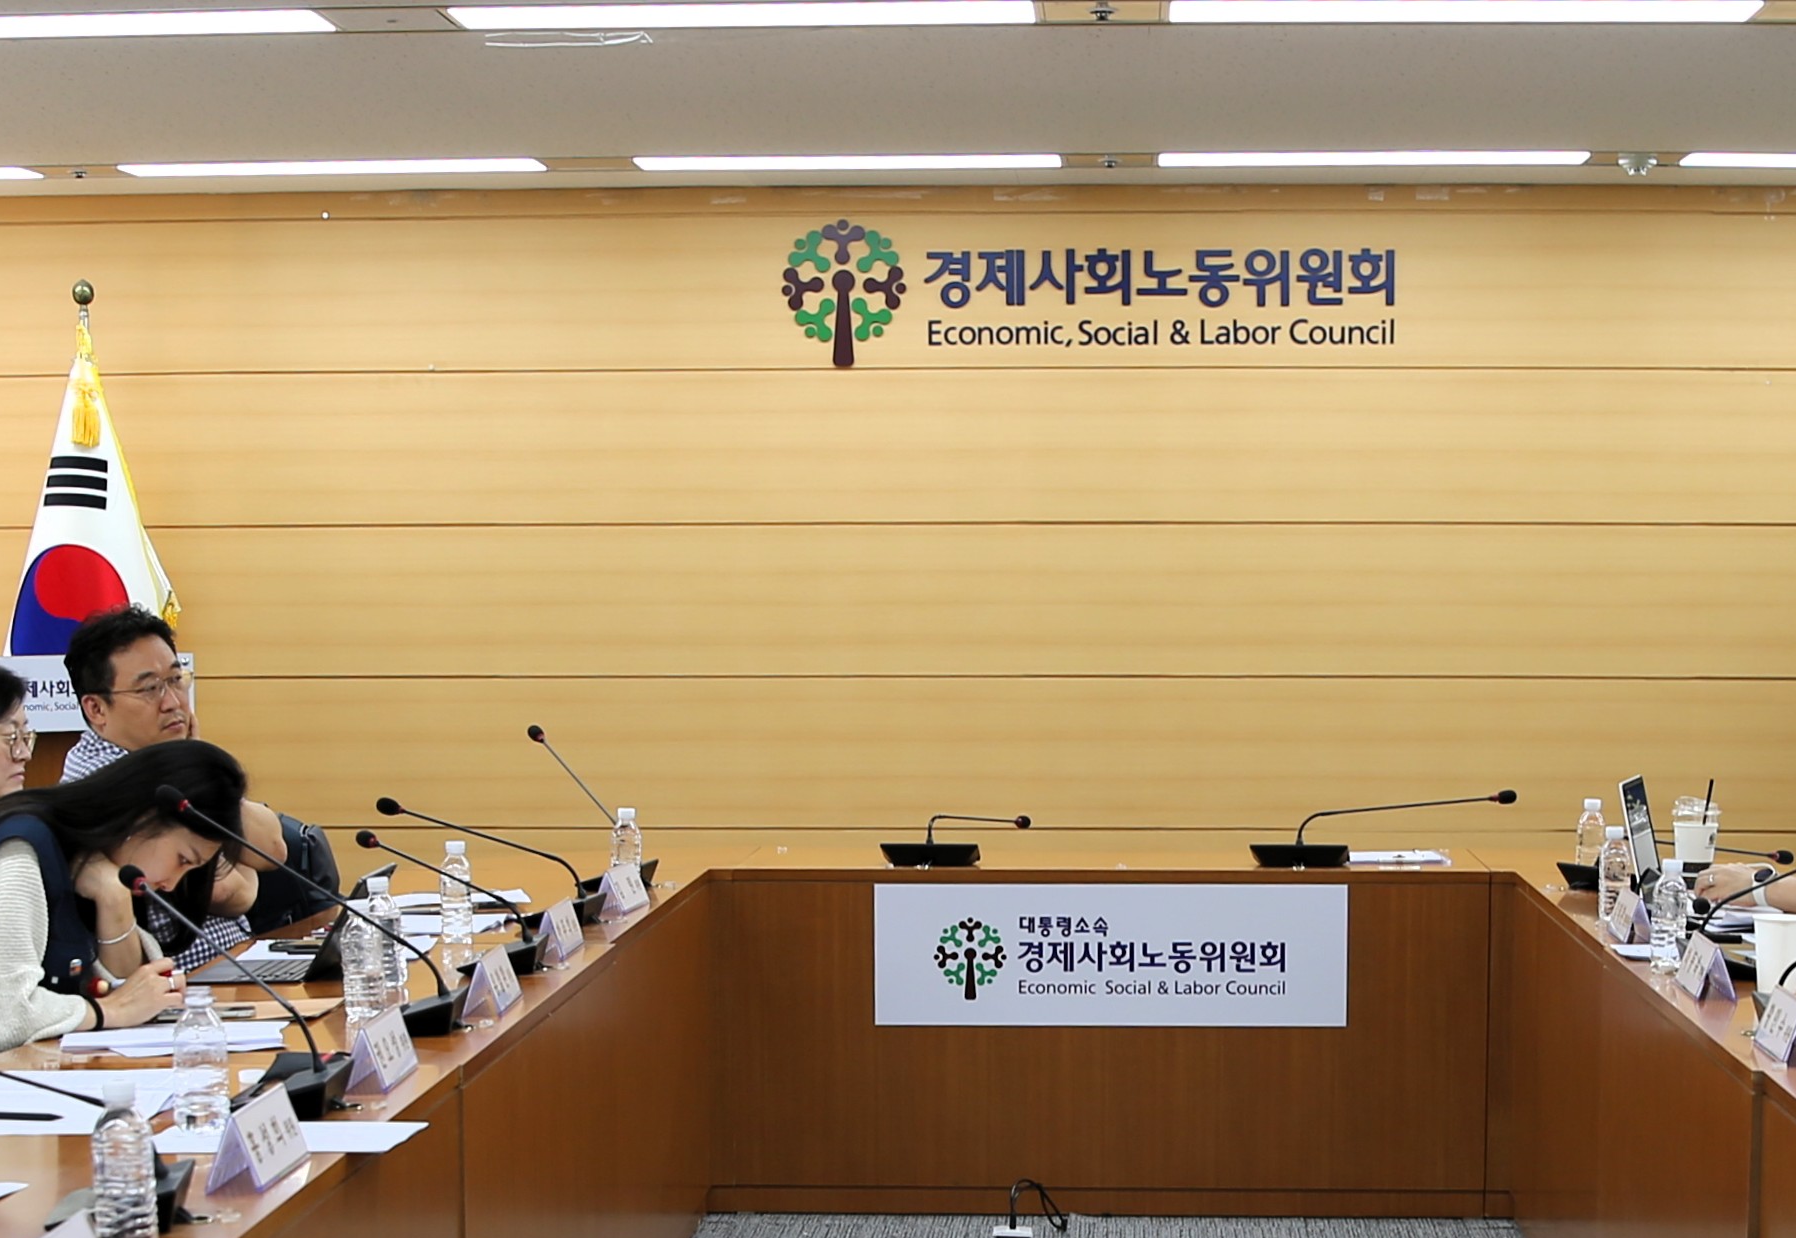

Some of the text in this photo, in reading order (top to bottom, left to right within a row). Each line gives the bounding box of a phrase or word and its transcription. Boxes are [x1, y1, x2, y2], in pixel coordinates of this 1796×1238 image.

[924, 248, 1396, 307] 경제사회노동위원회
[927, 319, 1396, 348] Economic, Social & Labor Council
[1018, 916, 1109, 937] 대통령소속
[1017, 941, 1286, 973] 경제사회노동위원회
[1018, 979, 1286, 995] Economic Social & Labor Council
